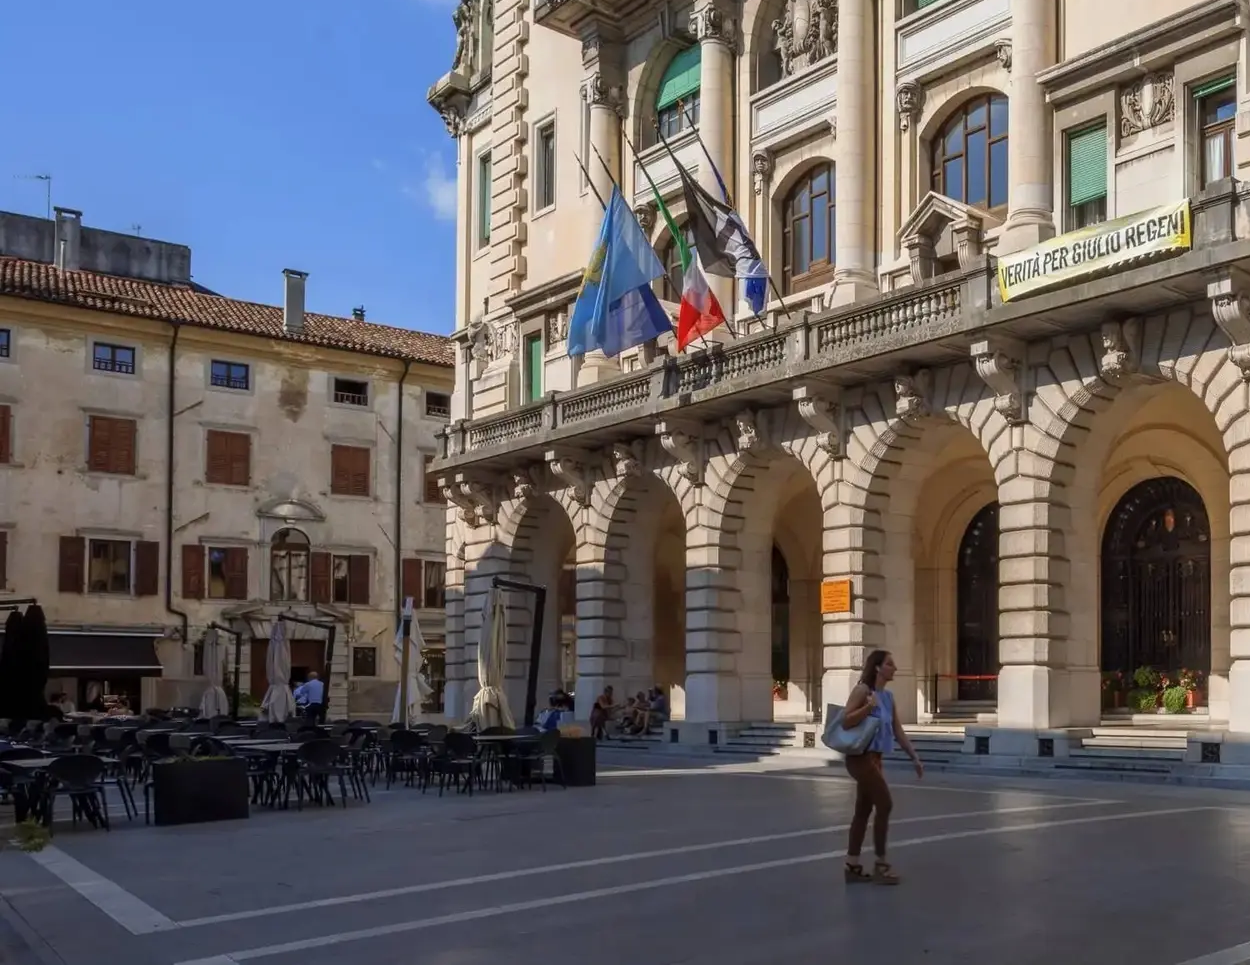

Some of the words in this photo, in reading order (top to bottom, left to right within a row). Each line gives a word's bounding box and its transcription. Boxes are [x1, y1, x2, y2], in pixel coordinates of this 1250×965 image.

[1001, 252, 1040, 289] VERITÀ
[1043, 246, 1068, 275] PER
[1072, 232, 1121, 264] GIULIO
[1125, 210, 1184, 249] REGENI
